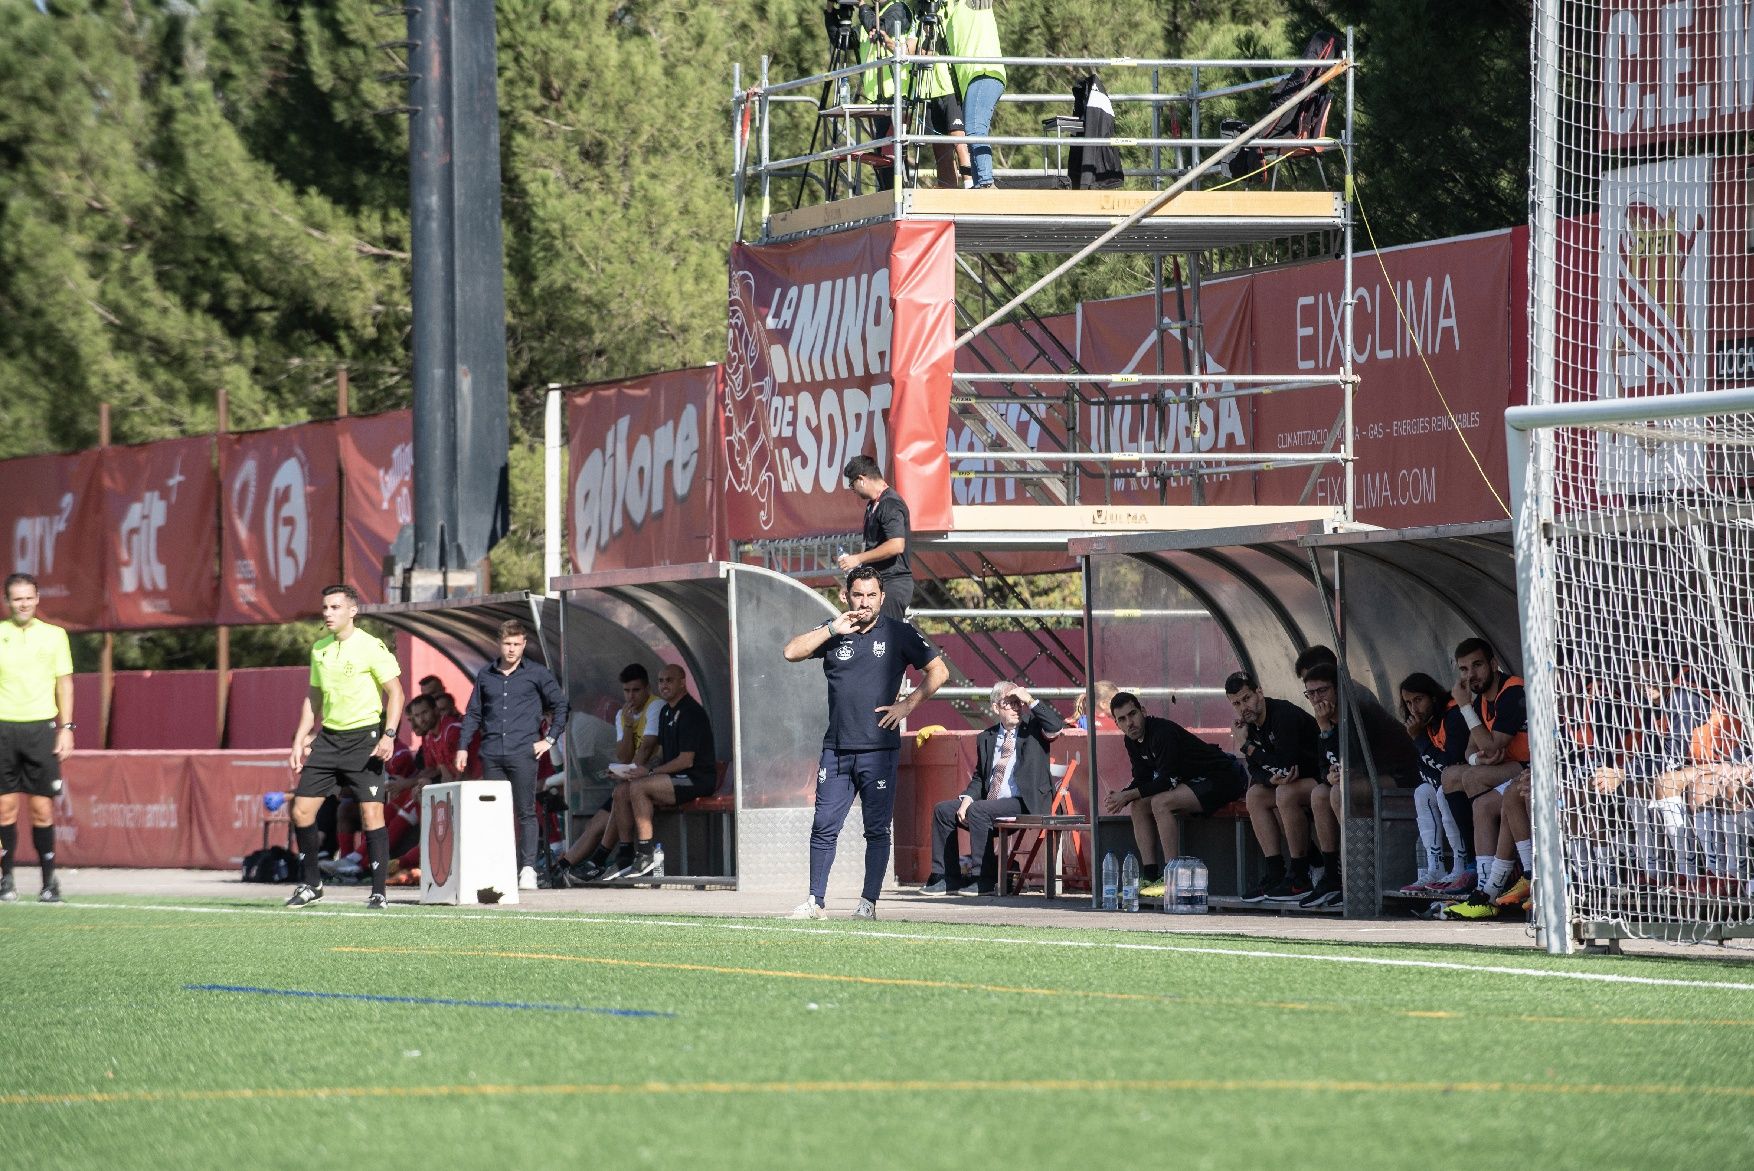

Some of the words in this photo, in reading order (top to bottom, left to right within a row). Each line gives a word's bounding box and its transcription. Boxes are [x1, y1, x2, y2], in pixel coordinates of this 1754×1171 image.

[766, 285, 799, 330] LA
[788, 268, 893, 384] MINA
[1296, 273, 1460, 369] EIXCLIMA
[770, 396, 794, 438] DE
[1368, 423, 1384, 439] GAS
[1393, 417, 1430, 437] ENERGIES
[775, 447, 797, 493] LA
[1317, 466, 1436, 509] EIXLIMA.COM
